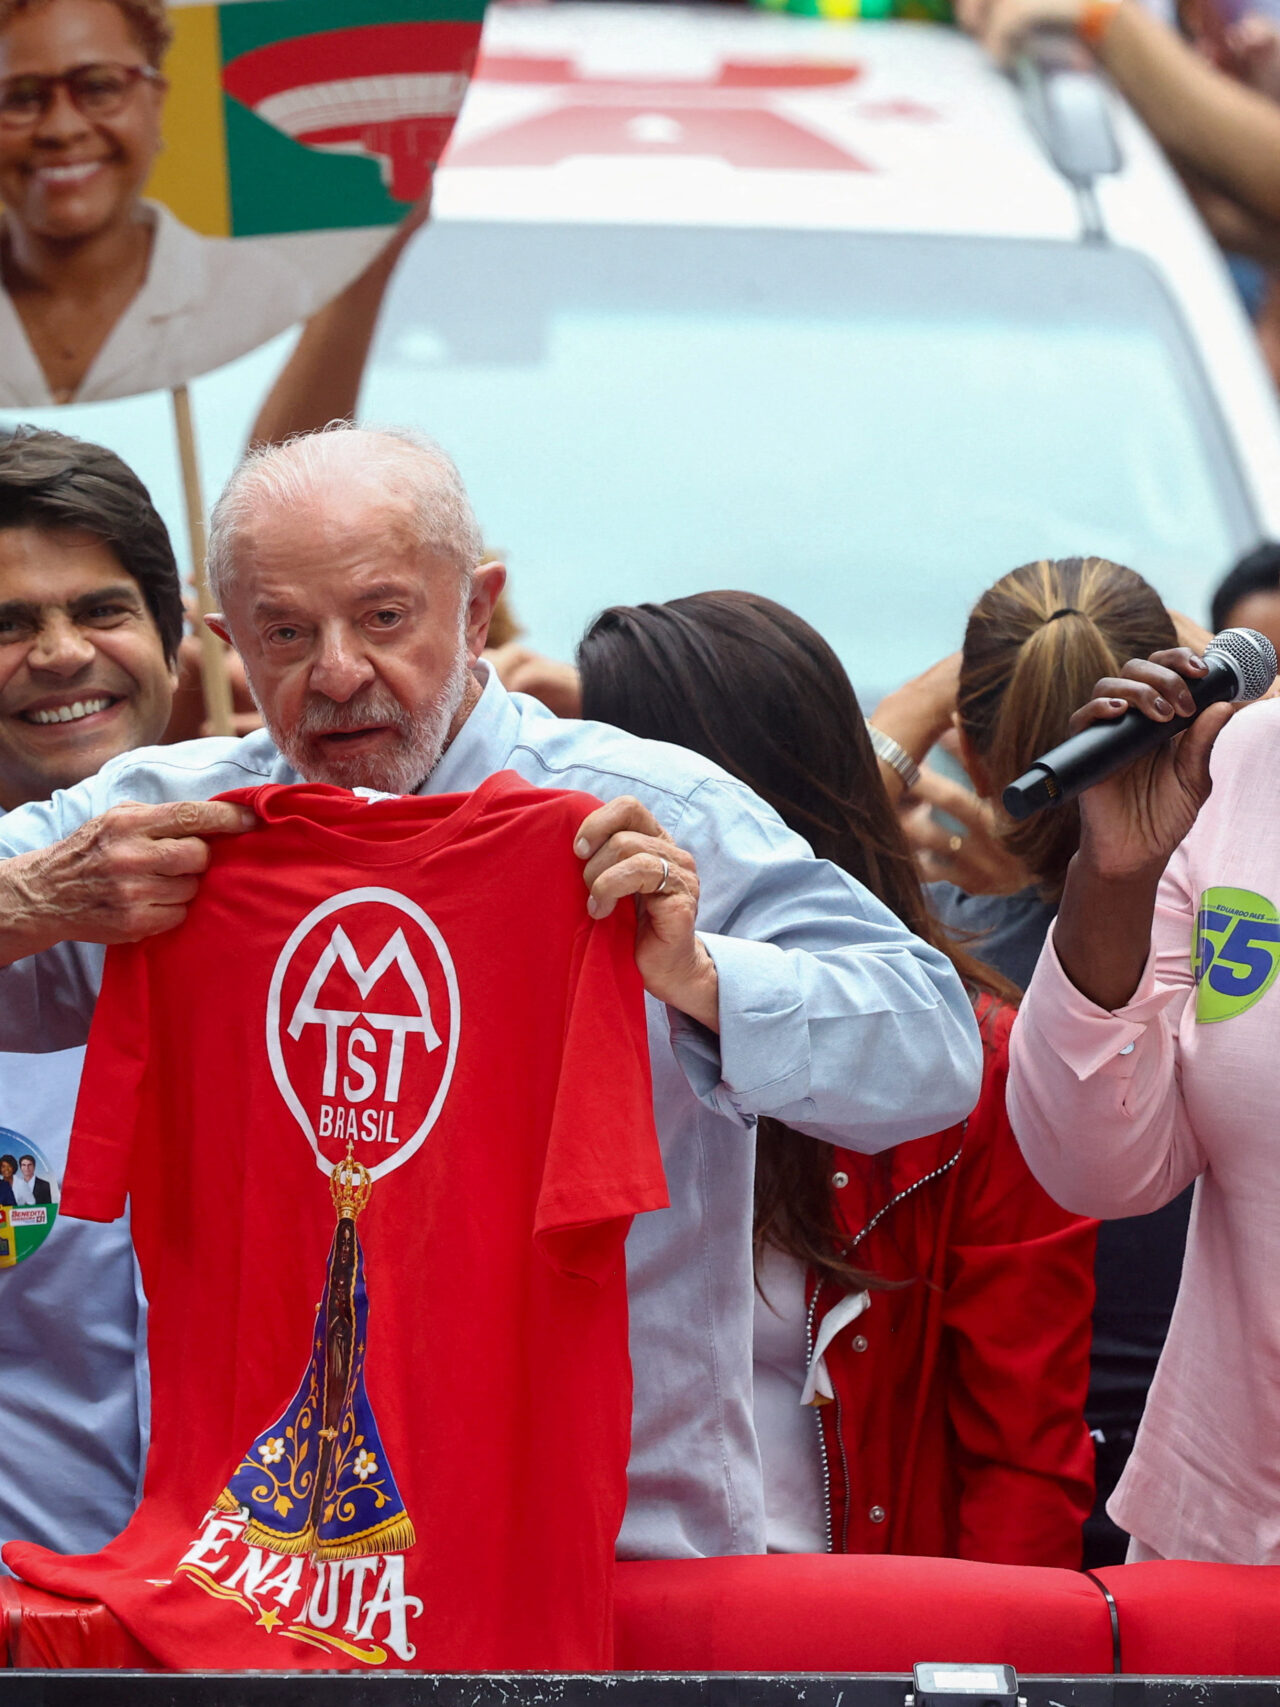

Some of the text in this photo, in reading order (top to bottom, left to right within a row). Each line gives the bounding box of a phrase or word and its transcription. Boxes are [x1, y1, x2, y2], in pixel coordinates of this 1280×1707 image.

[1216, 904, 1249, 918] EDUARDO
[319, 1104, 400, 1144] BRASIL
[11, 1210, 46, 1218] BENEDITA
[220, 1546, 306, 1608] NA
